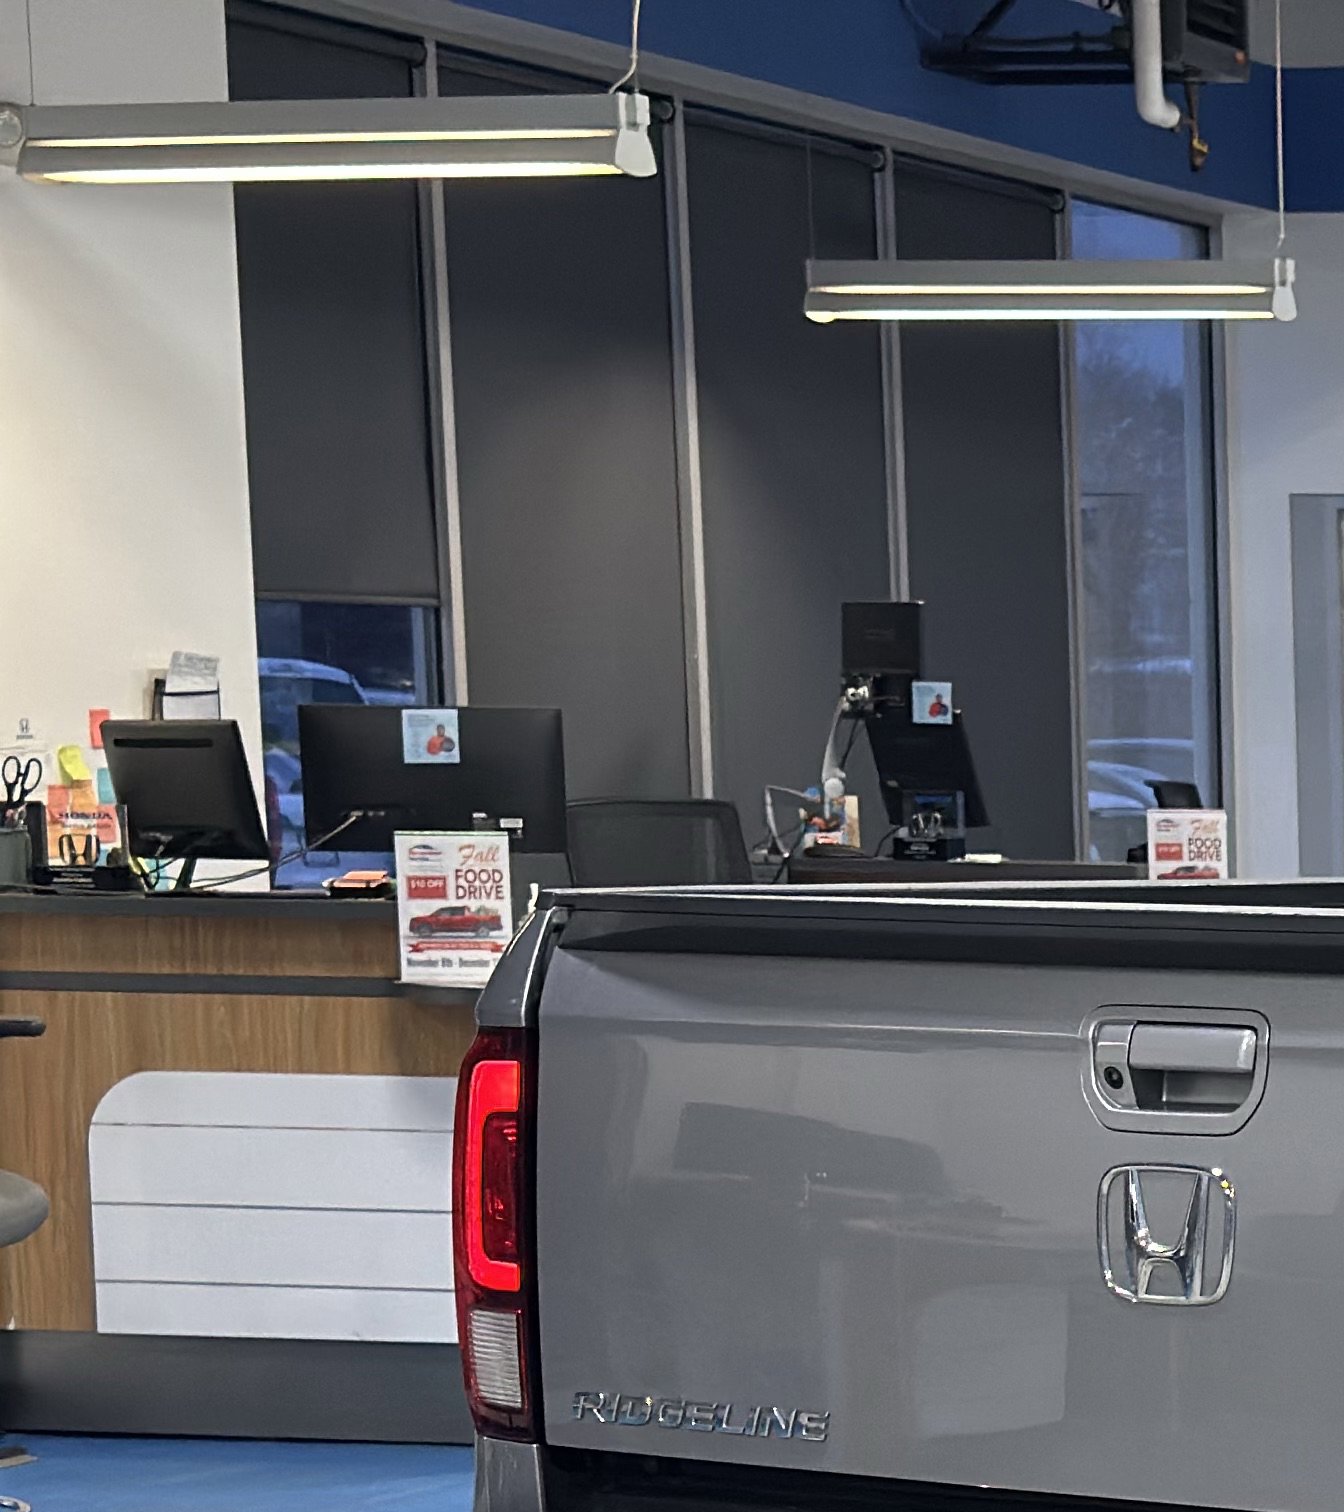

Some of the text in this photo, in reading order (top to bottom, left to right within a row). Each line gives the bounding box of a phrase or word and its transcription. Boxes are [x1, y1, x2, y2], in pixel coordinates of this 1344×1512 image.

[458, 844, 500, 866] Fall
[455, 869, 504, 884] FOOD
[456, 885, 505, 900] DRIVE
[572, 1391, 830, 1443] RIDGELINE
